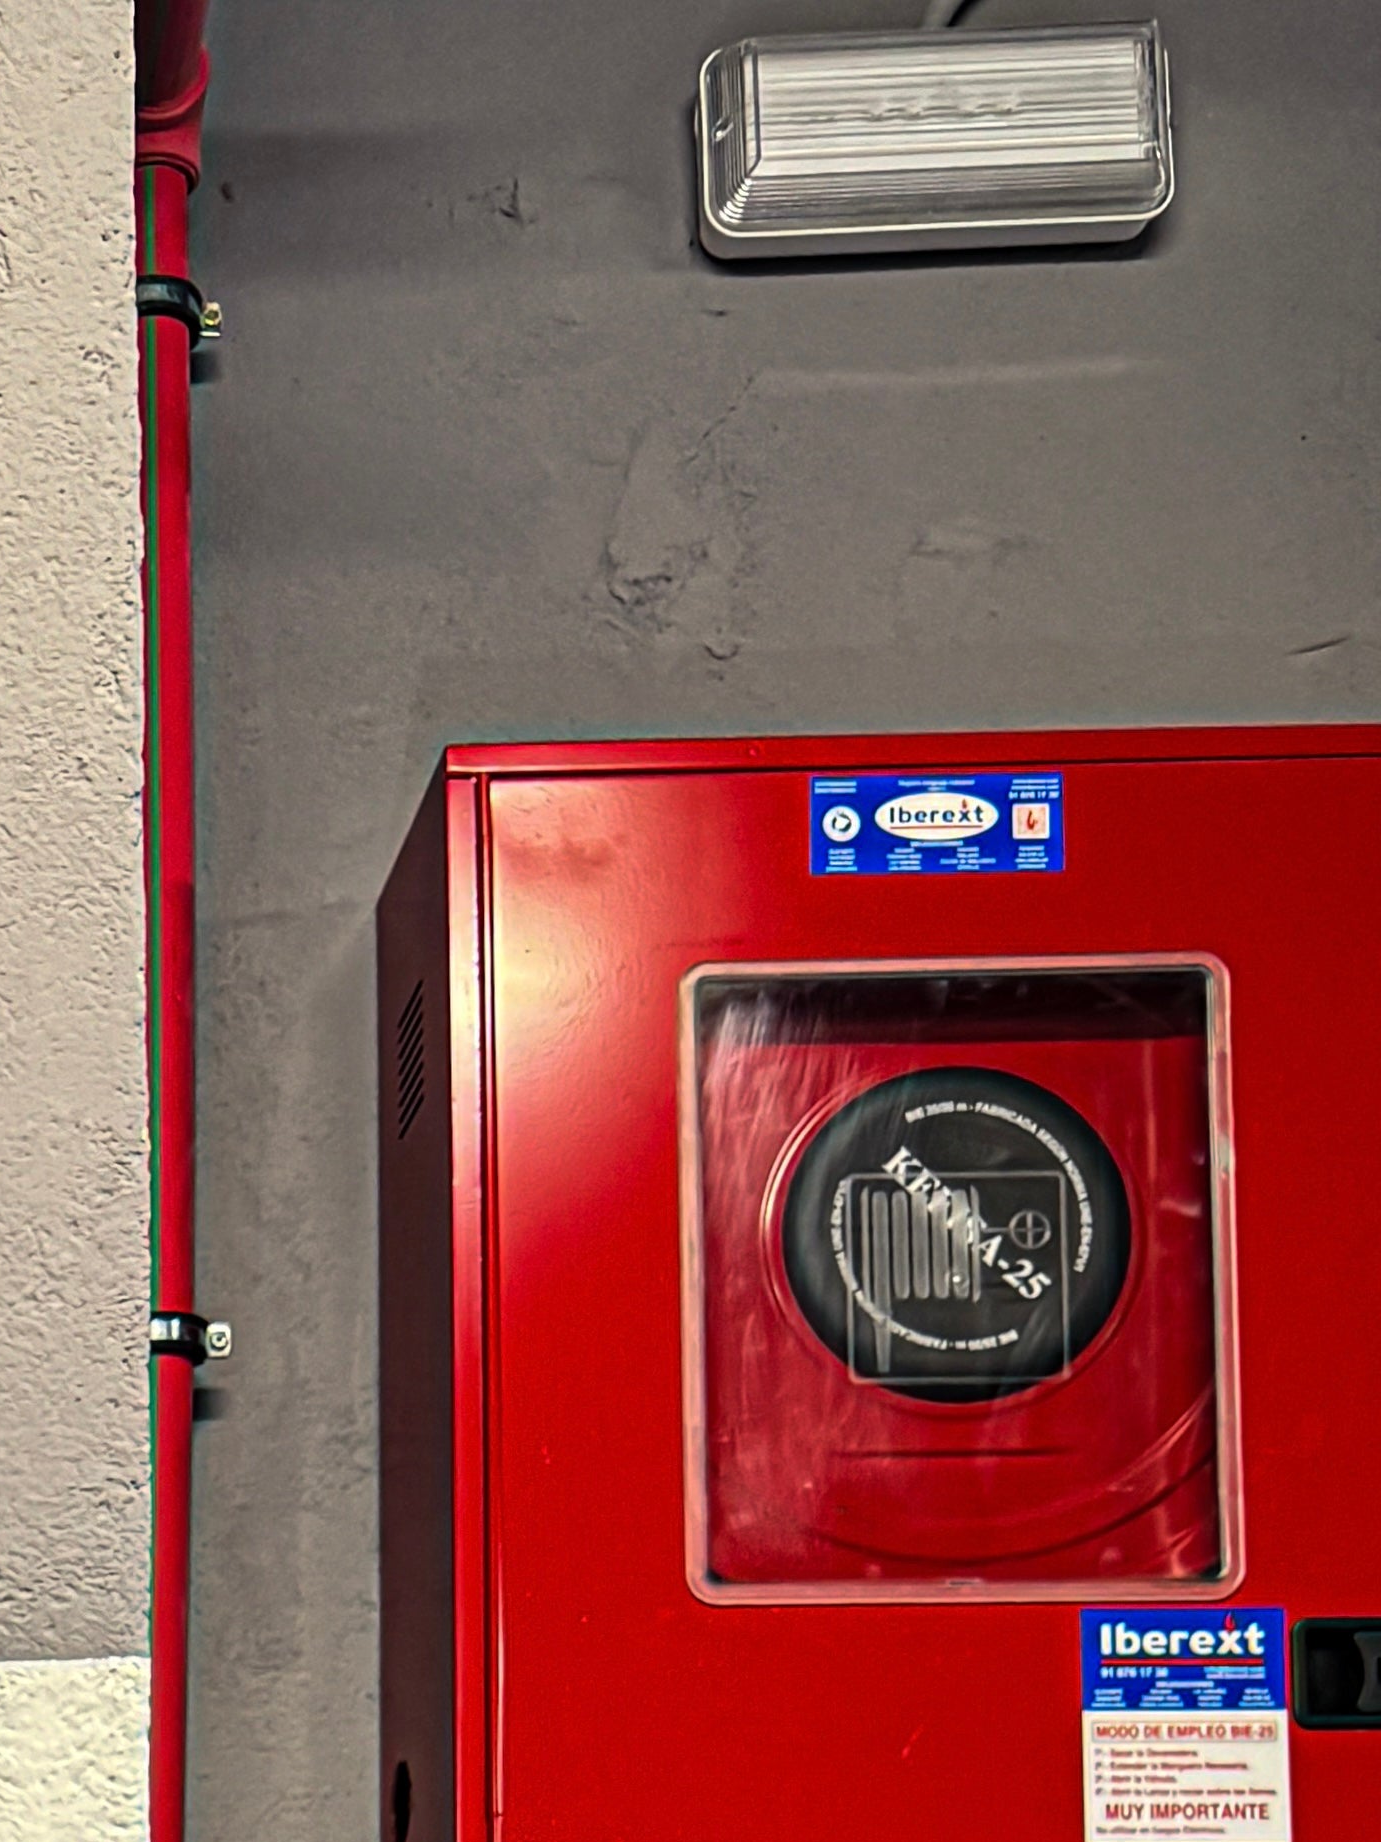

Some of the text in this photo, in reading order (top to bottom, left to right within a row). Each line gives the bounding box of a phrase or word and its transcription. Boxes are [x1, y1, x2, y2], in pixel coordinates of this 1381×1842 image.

[889, 805, 985, 824] Iberext
[1100, 1621, 1266, 1655] Iberext
[1096, 1725, 1274, 1739] MODO DE EMPLEO BIE-25
[1105, 1803, 1270, 1820] MUY IMPORTANTE
